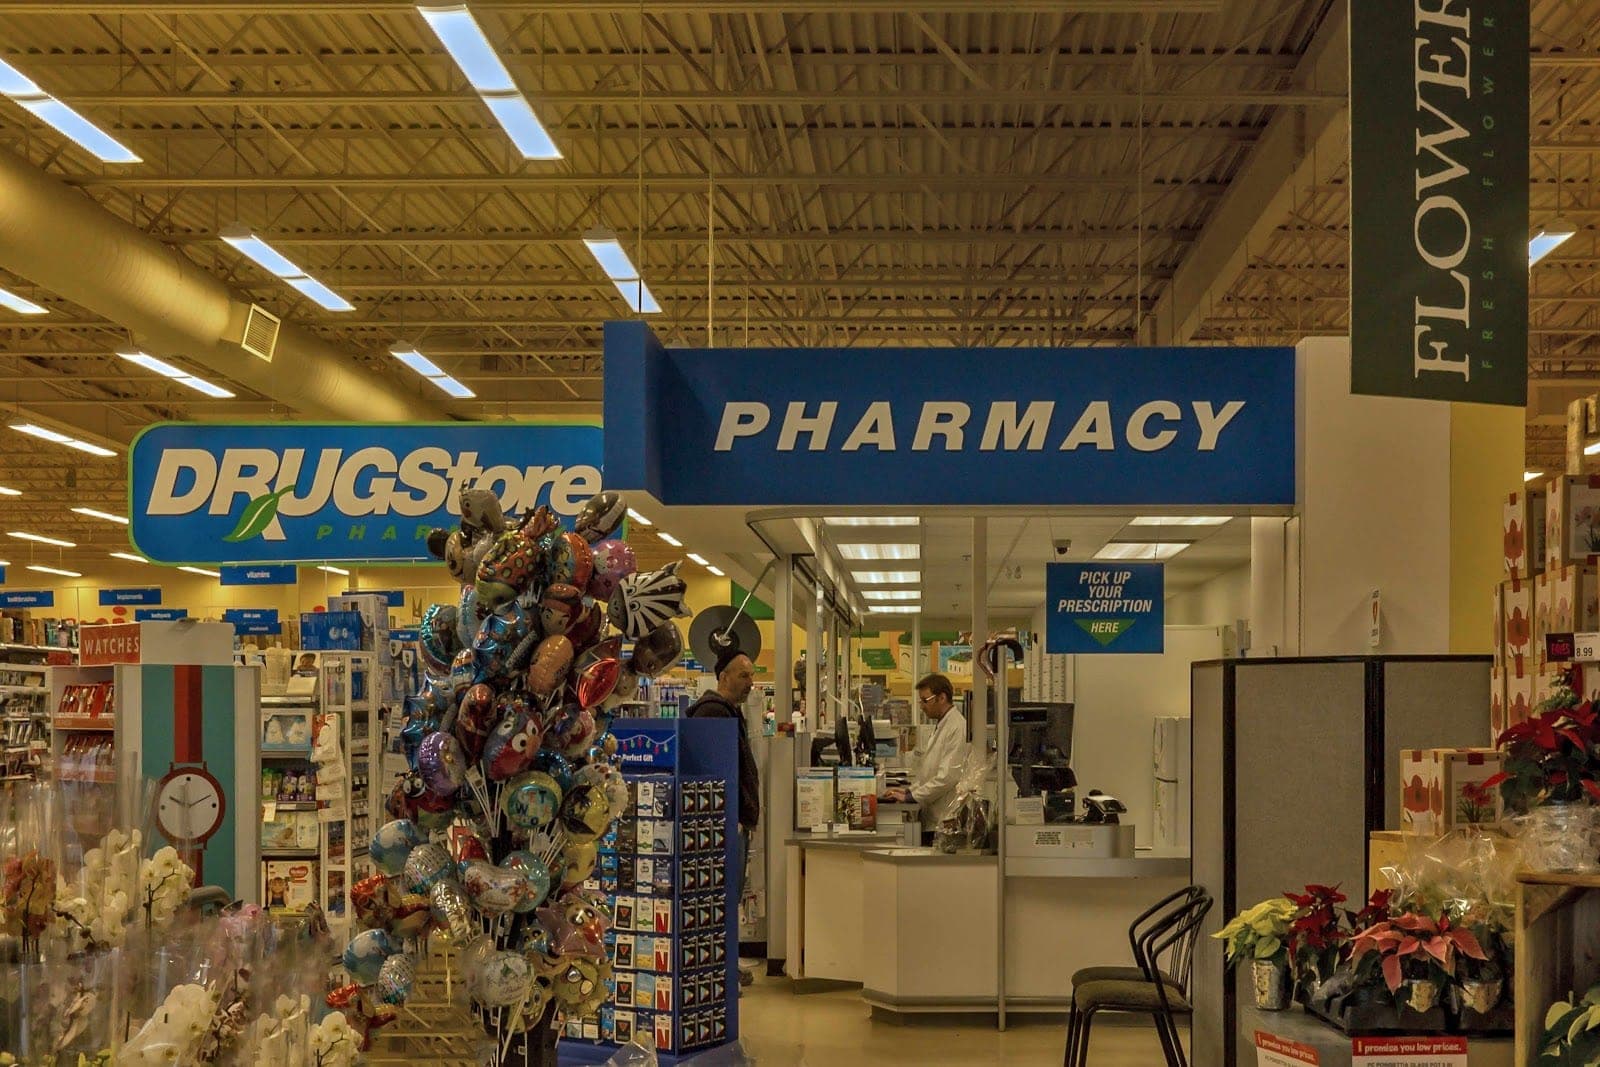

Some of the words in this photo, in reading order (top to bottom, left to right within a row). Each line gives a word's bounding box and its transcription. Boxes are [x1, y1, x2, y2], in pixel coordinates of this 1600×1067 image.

[1482, 16, 1495, 187] FLOWER
[1482, 237, 1495, 369] FRESH
[713, 401, 1247, 452] PHARMACY
[1079, 571, 1110, 585] PICK
[1113, 571, 1132, 585] UP
[1089, 585, 1123, 599] YOUR
[1057, 599, 1153, 613] PRESCRIPTION
[1091, 622, 1120, 633] HERE
[84, 636, 139, 655] WATCHES
[1576, 647, 1593, 657] 8.99
[622, 753, 642, 762] Perfect
[643, 753, 653, 762] Gift
[1364, 1043, 1399, 1054] promise
[1400, 1044, 1415, 1054] you
[1416, 1042, 1432, 1053] low
[1432, 1042, 1462, 1054] prices.
